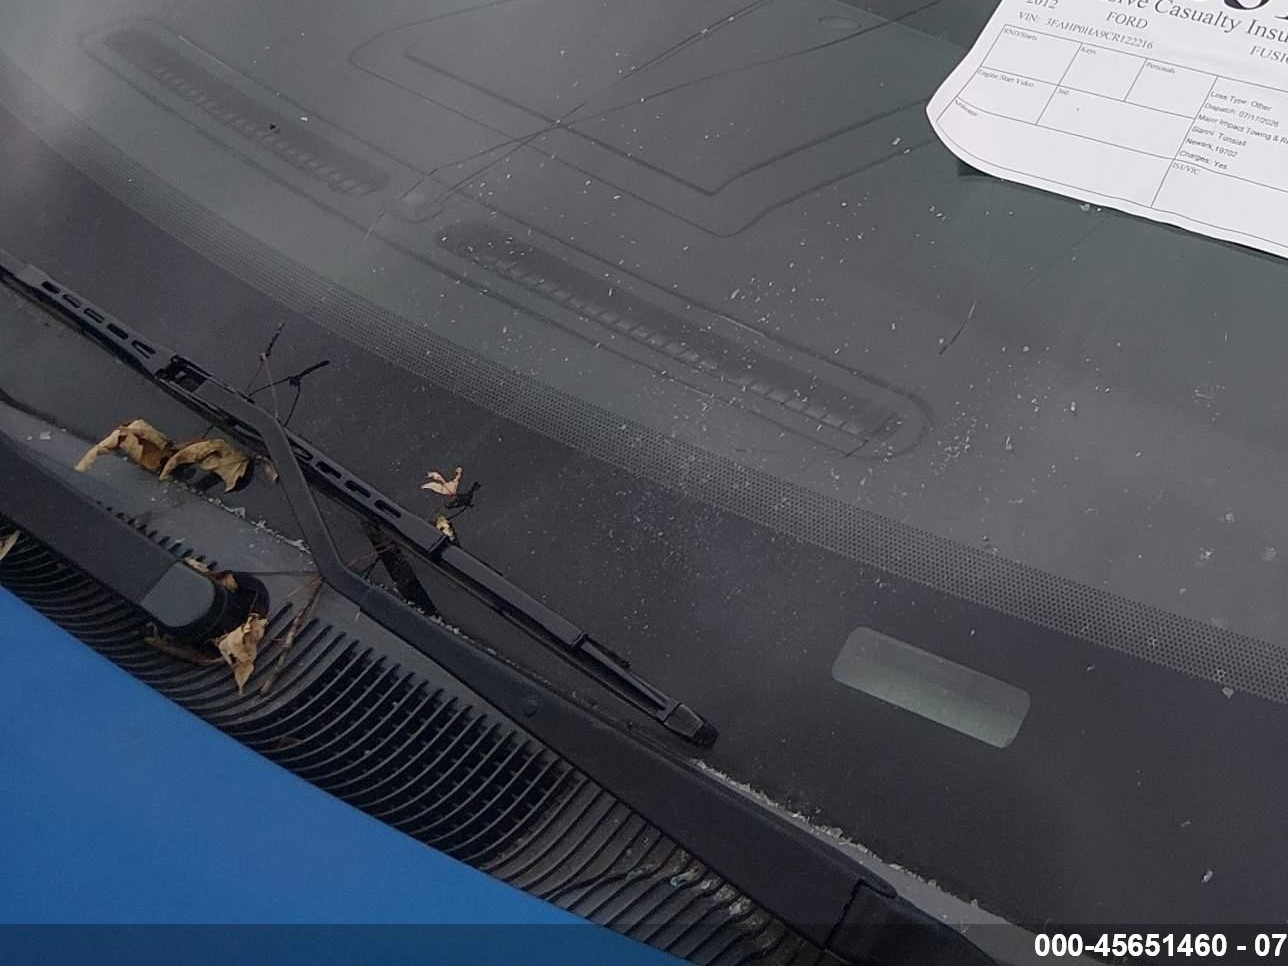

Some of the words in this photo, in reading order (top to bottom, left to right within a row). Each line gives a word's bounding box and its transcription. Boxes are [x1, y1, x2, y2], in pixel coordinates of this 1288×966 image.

[1019, 11, 1040, 22] VIN:
[1106, 11, 1148, 29] FORD
[1211, 91, 1228, 101] Loss
[1251, 100, 1273, 112] Other
[1199, 114, 1219, 126] Major
[1219, 119, 1245, 132] Impact
[1246, 128, 1272, 142] Towing
[1273, 134, 1280, 142] &
[1214, 160, 1228, 170] Yes
